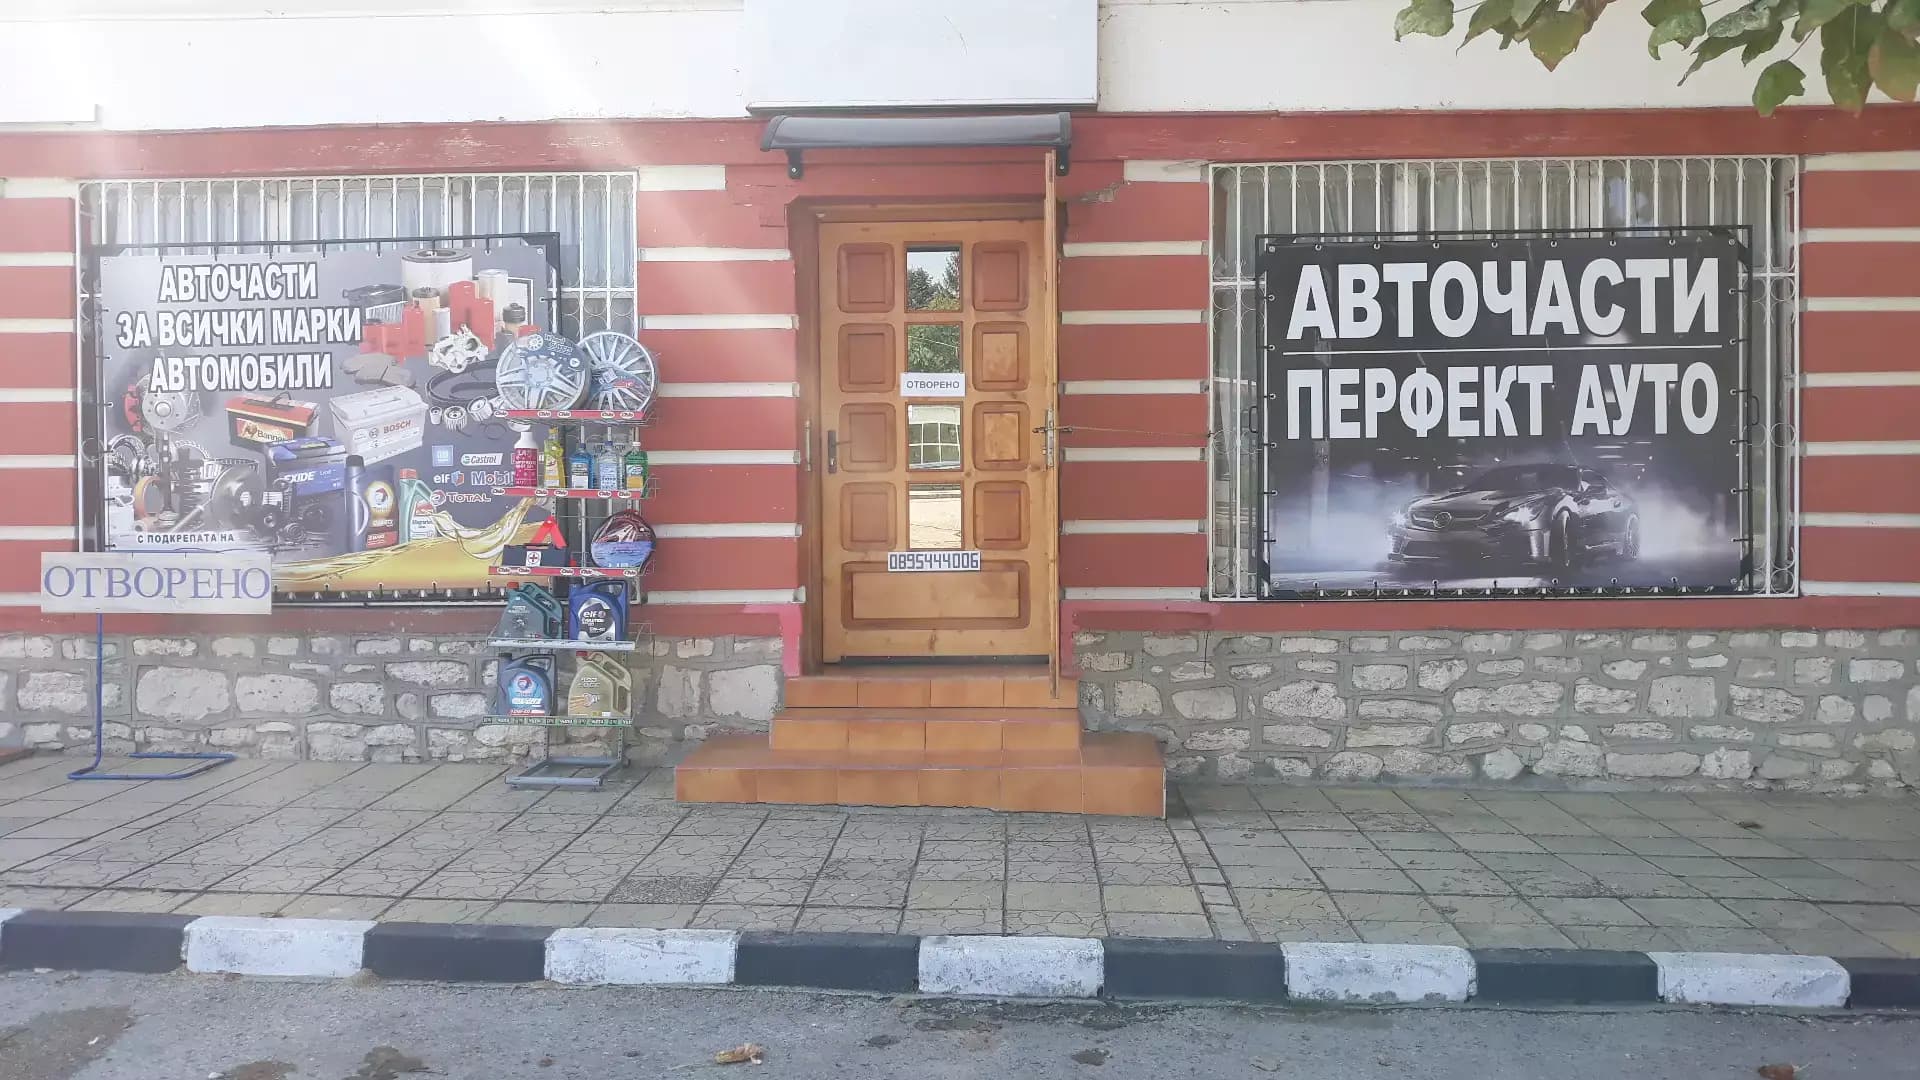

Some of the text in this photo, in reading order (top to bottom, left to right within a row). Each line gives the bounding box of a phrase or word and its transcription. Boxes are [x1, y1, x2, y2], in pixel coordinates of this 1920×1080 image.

[158, 262, 318, 302] АВТОЧАСТИ
[1286, 257, 1719, 340] АВТОЧАСТИ
[116, 306, 362, 348] ЗА ВСИЧКИ МАРКИ
[150, 353, 333, 392] АВТОМОБИЛИ
[906, 380, 960, 389] ОТВОРЕНО
[1287, 362, 1719, 440] ПЕРФЕКТ АУТО
[383, 418, 412, 434] BOSCH
[470, 455, 497, 464] Castrol
[433, 473, 451, 484] elf
[446, 491, 492, 503] TOTAL
[137, 533, 235, 545] С ПОДКРЕПАТА НА
[889, 553, 979, 570] 0895444006
[44, 566, 270, 599] ОТВОРЕНО
